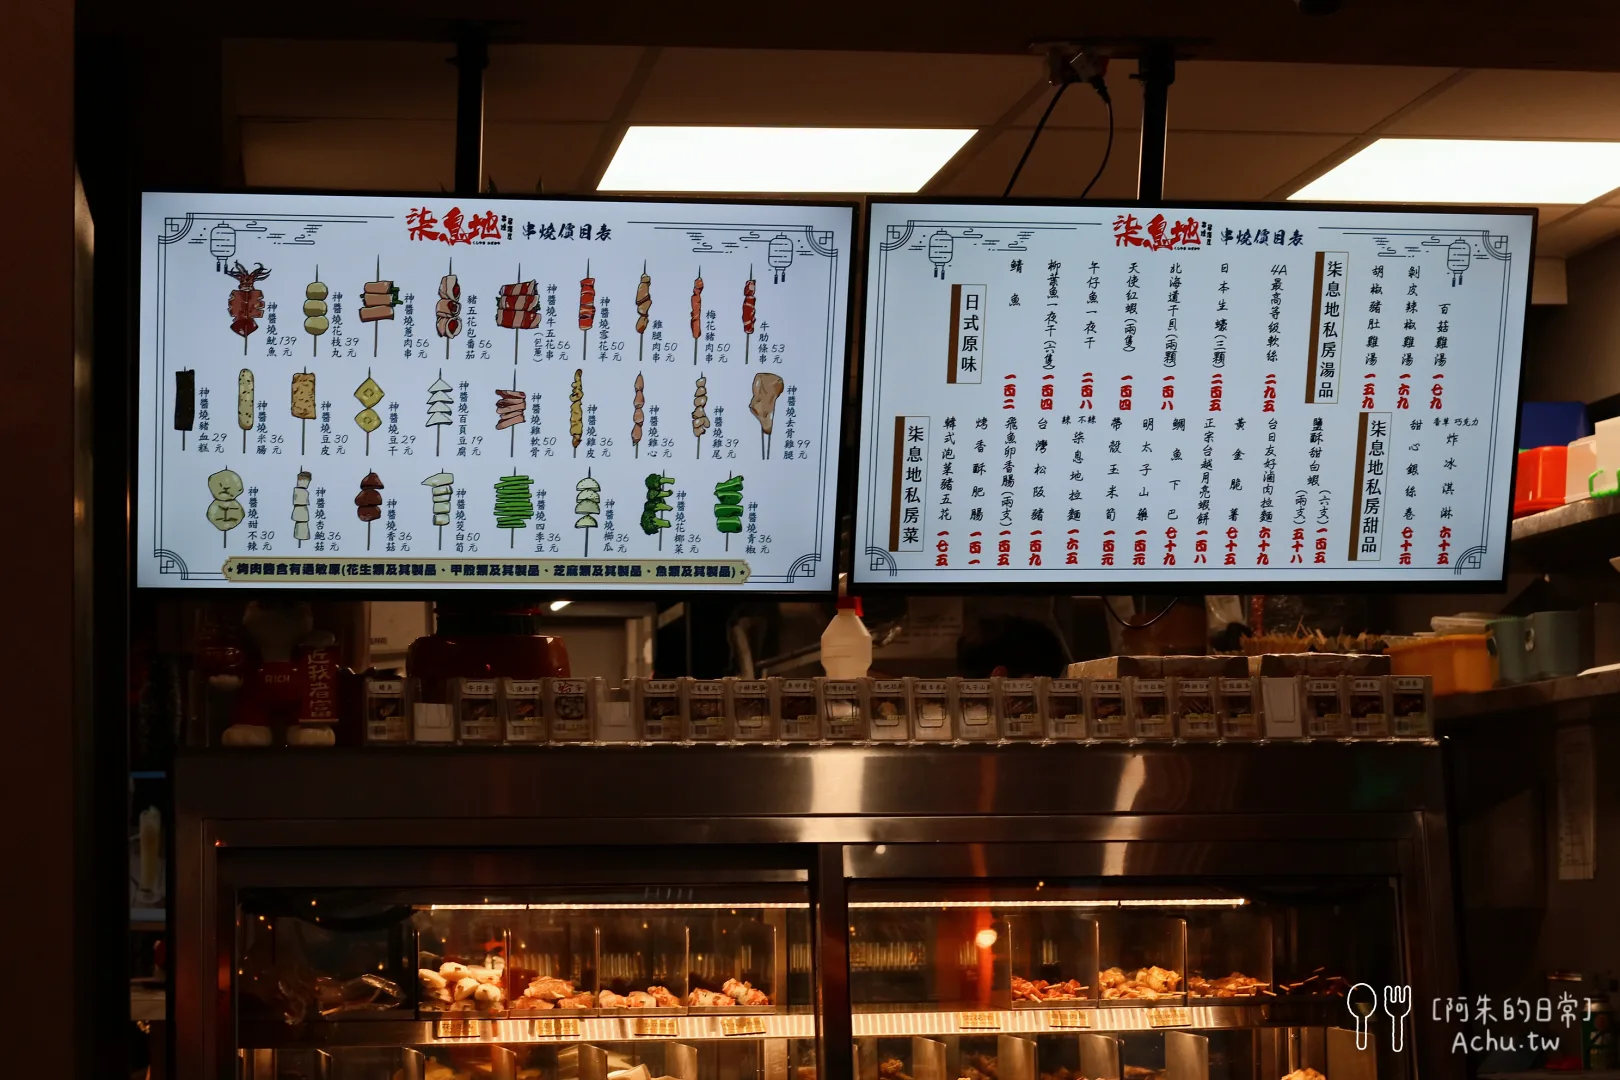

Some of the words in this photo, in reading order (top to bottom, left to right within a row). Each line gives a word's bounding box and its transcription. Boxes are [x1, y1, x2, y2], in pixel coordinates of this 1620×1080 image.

[523, 221, 611, 241] 串燒價目表
[1221, 228, 1303, 246] 串燒價目表
[1009, 259, 1023, 306] 鯖魚
[1084, 261, 1100, 349] 午仔魚一夜干
[266, 302, 277, 357] 神醬燒魷魚
[331, 292, 343, 357] 神醬燒花枝丸
[466, 295, 477, 359] 豬五花包番茄
[545, 284, 558, 360] 神醬燒牛五花串
[599, 297, 610, 362] 神醬燒雪花羊
[705, 310, 718, 363] 梅花豬肉串
[961, 294, 979, 373] 日式原味
[1267, 265, 1287, 362] 4A最高等級軟絲
[1318, 260, 1343, 399] 柒息地私房湯品
[1366, 265, 1384, 366] 胡椒豬肚雞湯
[1402, 266, 1420, 366] 剝皮辣椒雞湯
[1434, 304, 1451, 367] 百菇雞湯
[652, 320, 662, 363] 雞腿肉串
[758, 321, 769, 364] 牛肋條串
[1003, 374, 1016, 409] 一百二
[1041, 375, 1054, 410] 一百四
[1080, 372, 1093, 409] 二百八
[1119, 375, 1133, 410] 一百四
[1161, 376, 1175, 410] 一百八
[1209, 374, 1223, 411] 二百五
[1262, 374, 1276, 412] 二九五
[1362, 374, 1376, 409] 一五九
[1397, 374, 1411, 409] 一六九
[1430, 374, 1444, 409] 一七九
[198, 387, 210, 452] 神醬燒豬血糕
[256, 400, 268, 455] 神醬燒米腸
[320, 401, 331, 455] 神醬燒豆皮
[388, 402, 399, 456] 神醬燒豆干
[457, 381, 469, 457] 神醬燒百頁豆腐
[530, 393, 541, 457] 神醬燒雞軟骨
[586, 405, 597, 458] 神醬燒雞皮
[648, 405, 659, 457] 神醬燒雞心
[712, 406, 724, 459] 神醬燒雞尾
[782, 384, 798, 460] 神醬燒去骨雞腿
[1454, 418, 1478, 426] 巧克力
[938, 416, 956, 520] 韓式泡菜豬五花
[970, 417, 988, 521] 烤香酥肥腸
[1031, 418, 1048, 521] 台灣松阪豬
[1067, 431, 1084, 521] 柒息地拉麵
[1106, 417, 1122, 521] 帶殼玉米筍
[1136, 418, 1153, 521] 明太子山藥
[1168, 418, 1185, 520] 鯛魚下巴
[1196, 418, 1216, 525] 正宗台越月亮蝦餅
[1228, 417, 1246, 521] 黃金脆薯
[1260, 418, 1277, 522] 台日友好滷肉拉麵
[1307, 417, 1323, 486] 鹽酥甜白蝦
[1403, 419, 1423, 520] 甜心銀絲卷
[1441, 433, 1458, 519] 炸冰淇淋
[902, 425, 924, 544] 柒息地私房菜
[1361, 420, 1387, 553] 柒息地私房甜品
[247, 487, 258, 551] 神醬燒甜不辣
[314, 487, 326, 551] 神醬燒杏鮑菇
[386, 499, 397, 551] 神醬燒香菇
[535, 489, 548, 552] 神醬燒四季豆
[603, 499, 615, 551] 神醬燒櫛瓜
[674, 491, 686, 554] 神醬燒花椰菜
[746, 502, 758, 554] 神醬燒青椒
[1290, 528, 1304, 563] 五十八
[1314, 528, 1328, 563] 一百五
[1437, 526, 1451, 564] 六十五
[935, 531, 949, 566] 一七五
[968, 532, 982, 564] 一百一
[997, 530, 1011, 566] 一百五
[1029, 530, 1042, 566] 一百九
[1065, 529, 1079, 564] 一六五
[1101, 530, 1115, 565] 一百元
[1133, 530, 1147, 565] 一百元
[1163, 527, 1177, 565] 七十九
[1194, 530, 1208, 563] 一百八
[1224, 527, 1238, 565] 七十五
[1257, 527, 1271, 565] 六十九
[1399, 527, 1413, 565] 七十元
[264, 674, 290, 684] RICH
[307, 650, 332, 718] 近我者富
